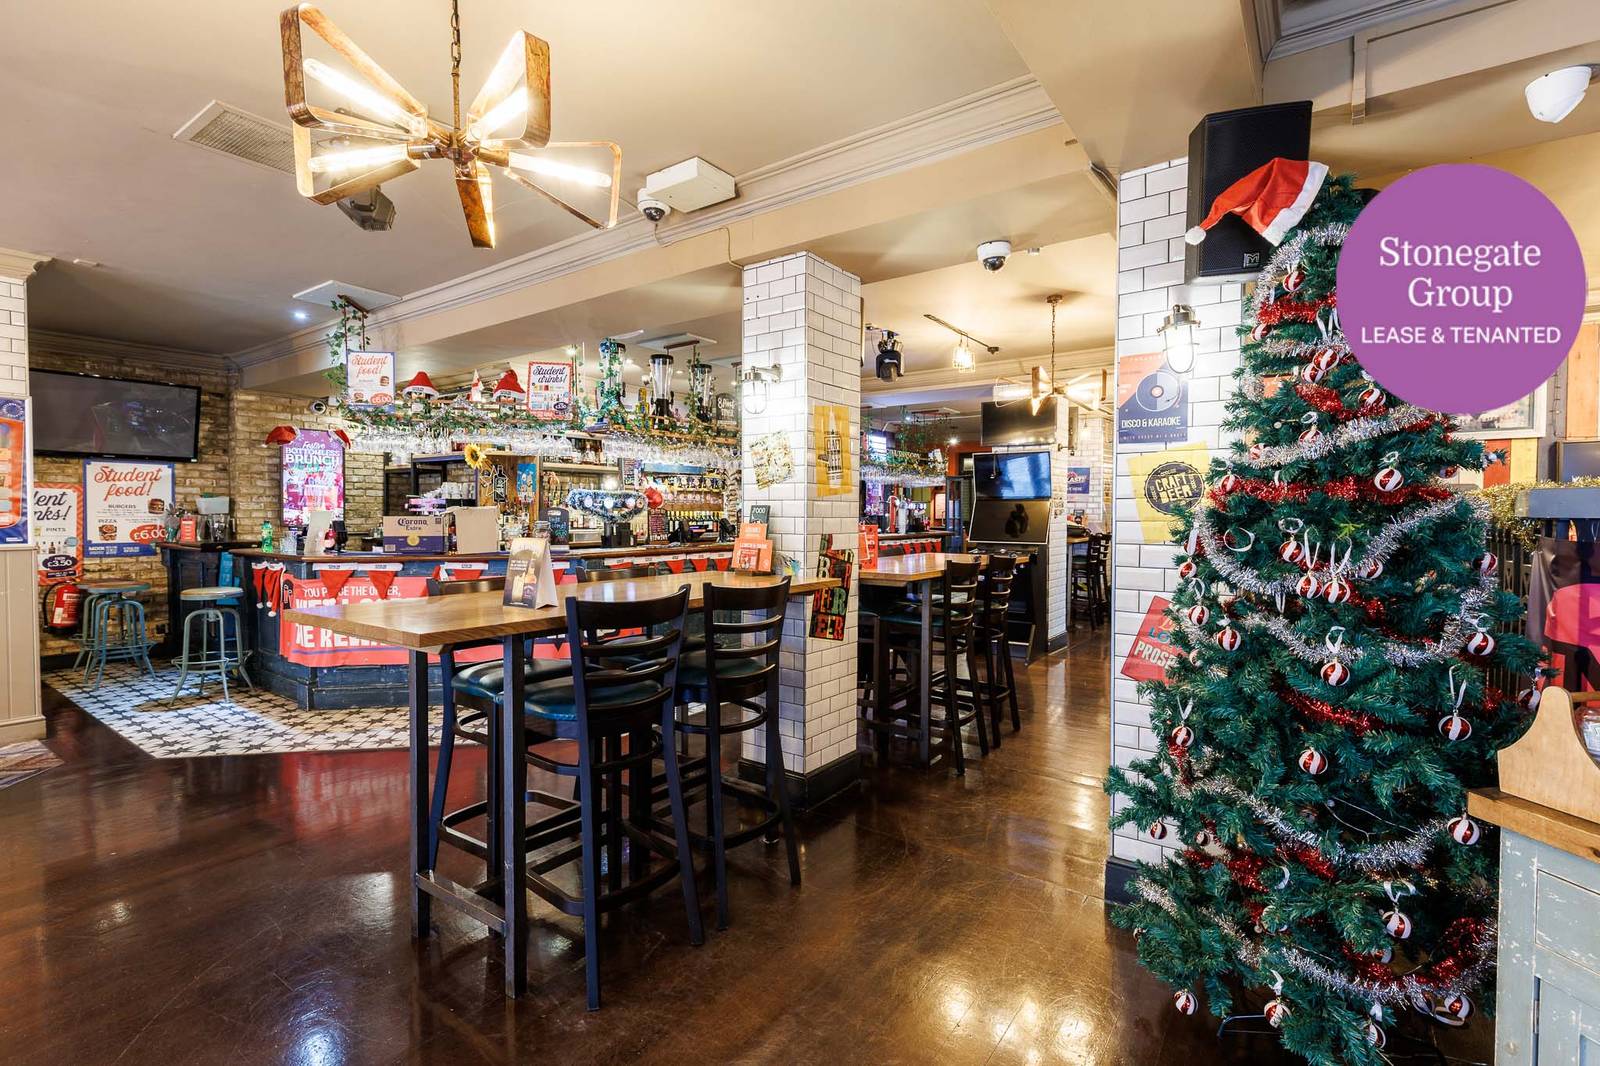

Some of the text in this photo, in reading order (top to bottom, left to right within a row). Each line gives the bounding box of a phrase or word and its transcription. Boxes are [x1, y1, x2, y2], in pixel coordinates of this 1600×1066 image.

[352, 355, 388, 365] Student
[356, 365, 383, 377] food!
[532, 366, 566, 375] Student
[538, 374, 568, 384] drinks!
[1121, 416, 1181, 428] DISCO & KARAOKE
[285, 448, 341, 456] BOTTOMLESS
[286, 454, 340, 465] BRUNCH
[94, 465, 162, 483] Student
[1155, 472, 1187, 491] CRAFT
[103, 482, 154, 501] food!
[1159, 485, 1192, 503] BEER
[397, 518, 428, 526] Corona
[303, 587, 320, 598] YOU
[350, 585, 368, 596] THE
